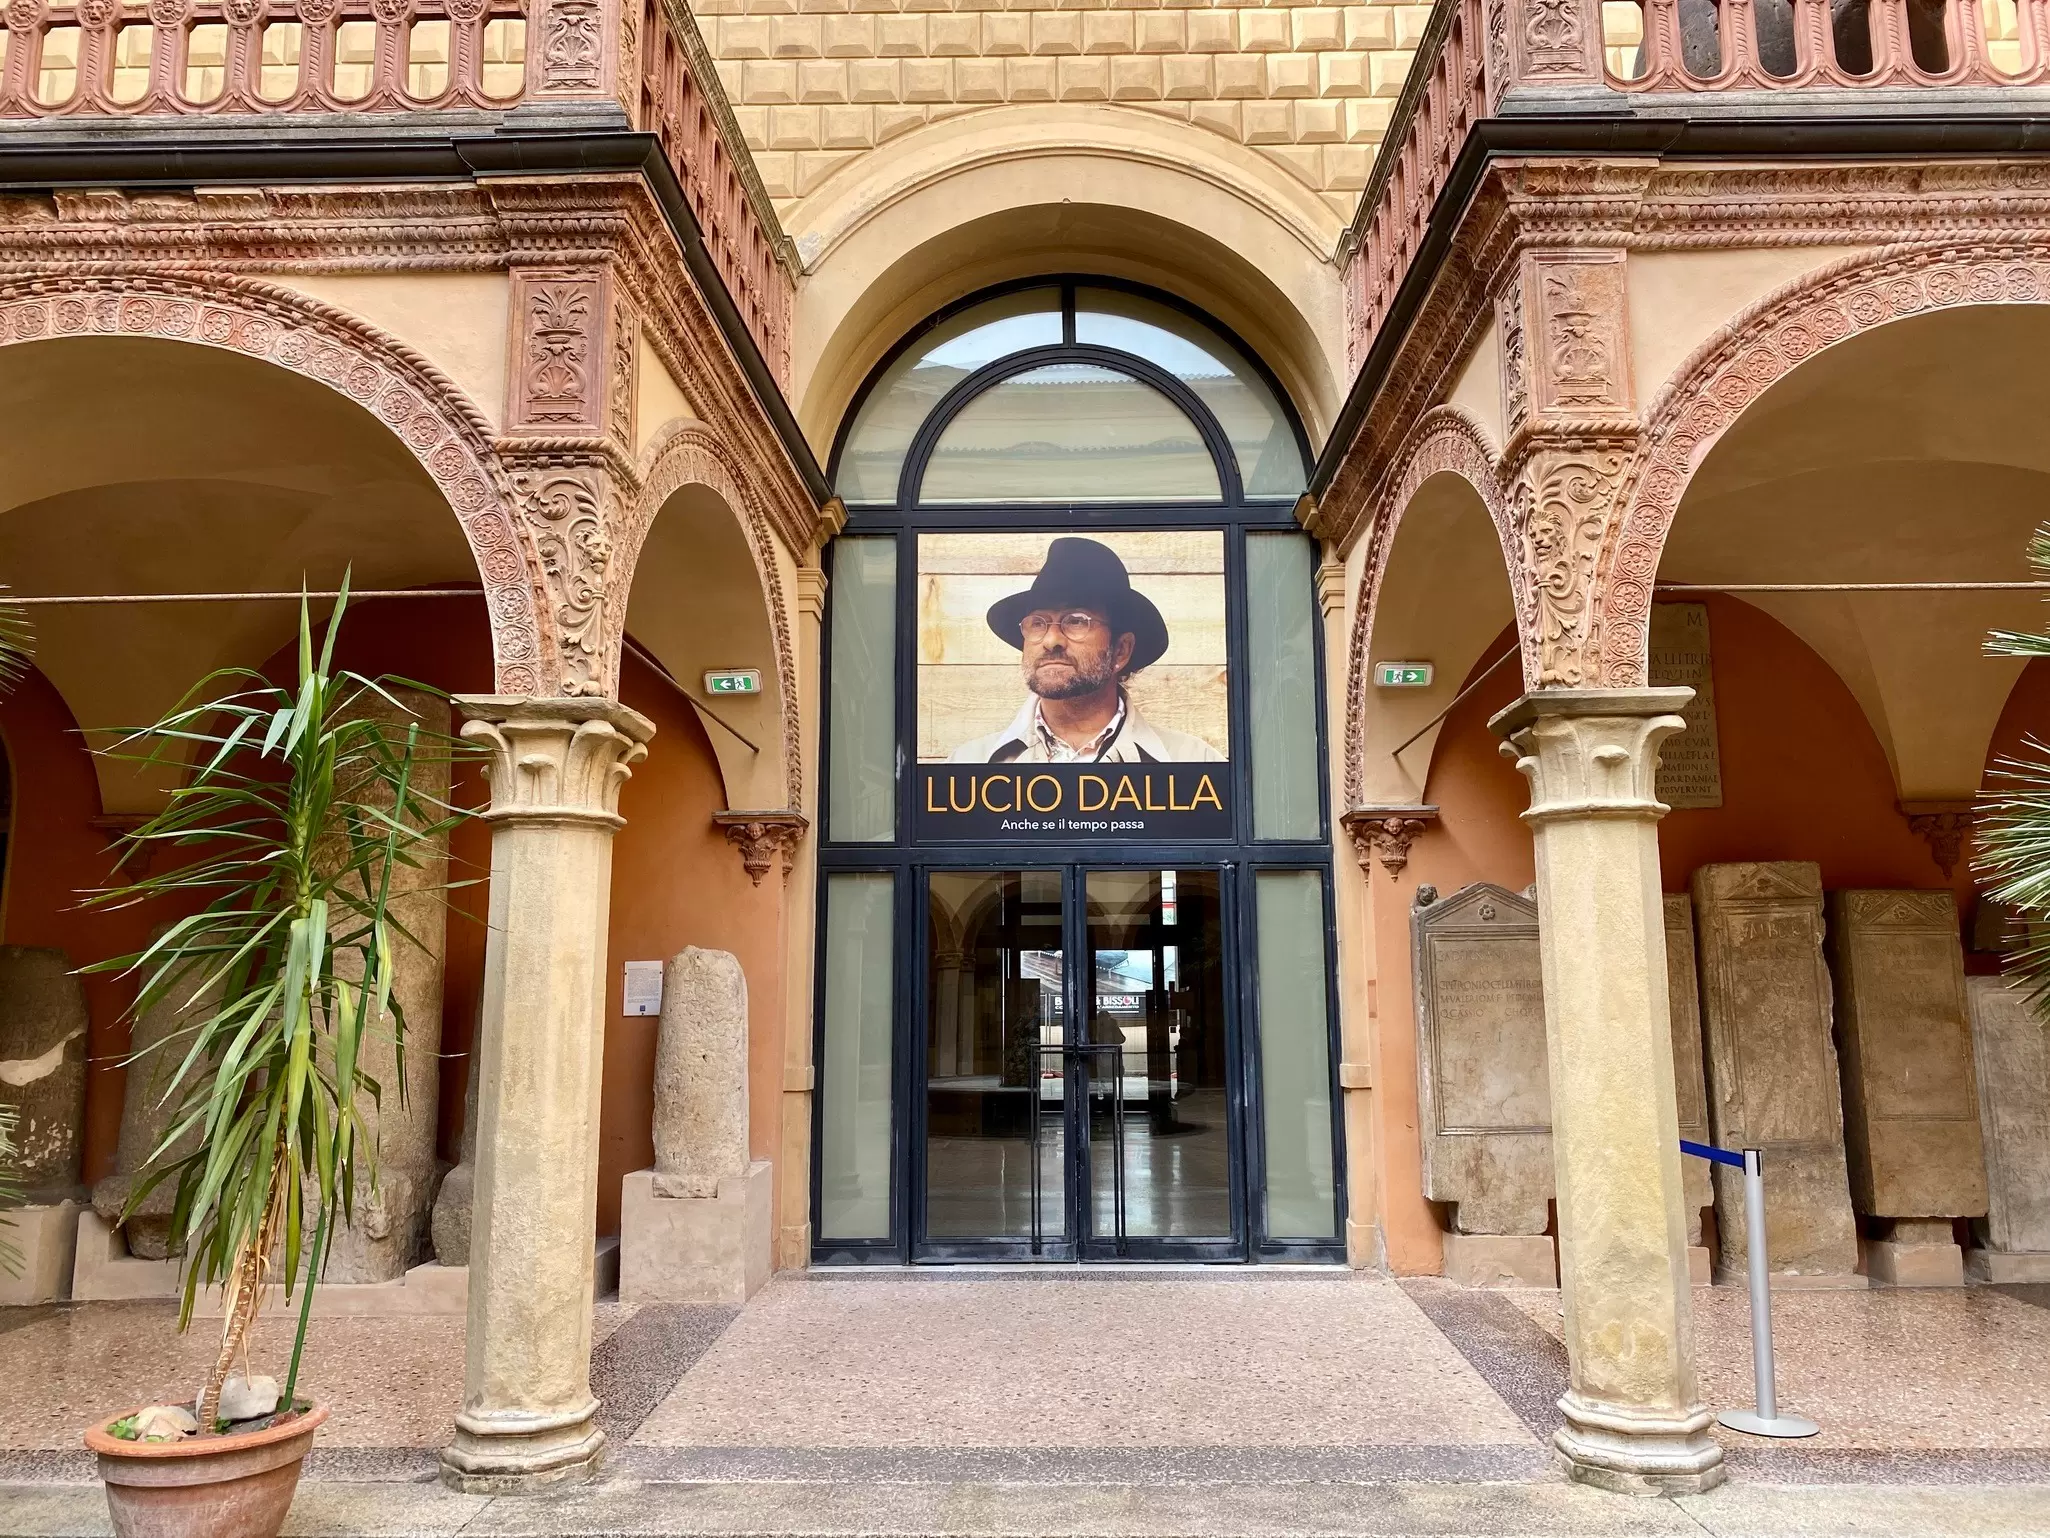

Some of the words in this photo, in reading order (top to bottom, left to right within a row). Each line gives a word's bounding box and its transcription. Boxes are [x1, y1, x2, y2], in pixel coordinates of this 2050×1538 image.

[927, 774, 1062, 812] LUCIO
[1078, 774, 1223, 811] DALLA
[1001, 818, 1039, 830] Anche
[1042, 820, 1056, 830] se
[1058, 818, 1065, 830] il
[1068, 819, 1108, 832] tempo
[1110, 820, 1145, 832] passa
